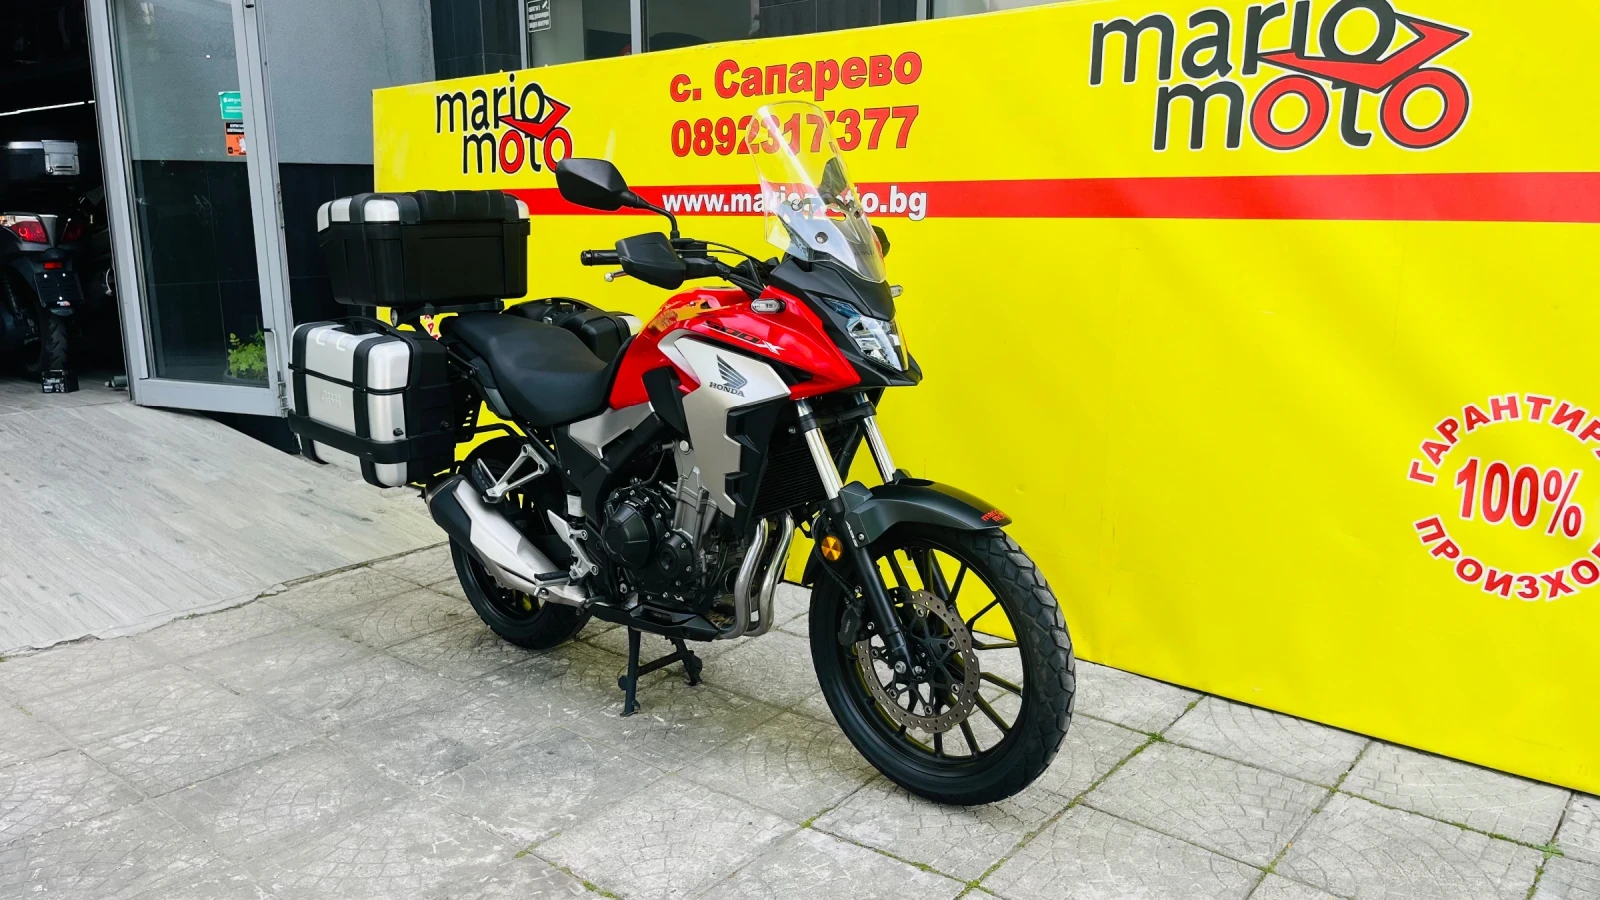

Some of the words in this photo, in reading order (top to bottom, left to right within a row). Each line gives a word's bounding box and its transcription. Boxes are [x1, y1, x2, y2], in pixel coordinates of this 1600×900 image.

[1089, 0, 1396, 85] mario
[435, 73, 546, 134] mario
[669, 74, 702, 102] с.
[714, 51, 923, 101] Сапарево
[670, 104, 920, 157] 0892317377
[1153, 67, 1470, 150] moto
[462, 127, 573, 174] moto
[661, 185, 929, 222] www.marioo.bg
[708, 381, 746, 398] HONDA
[1408, 396, 1600, 483] ГАРАНТИР
[1456, 459, 1583, 538] 100%
[1415, 517, 1600, 599] ПРОИЗХО
